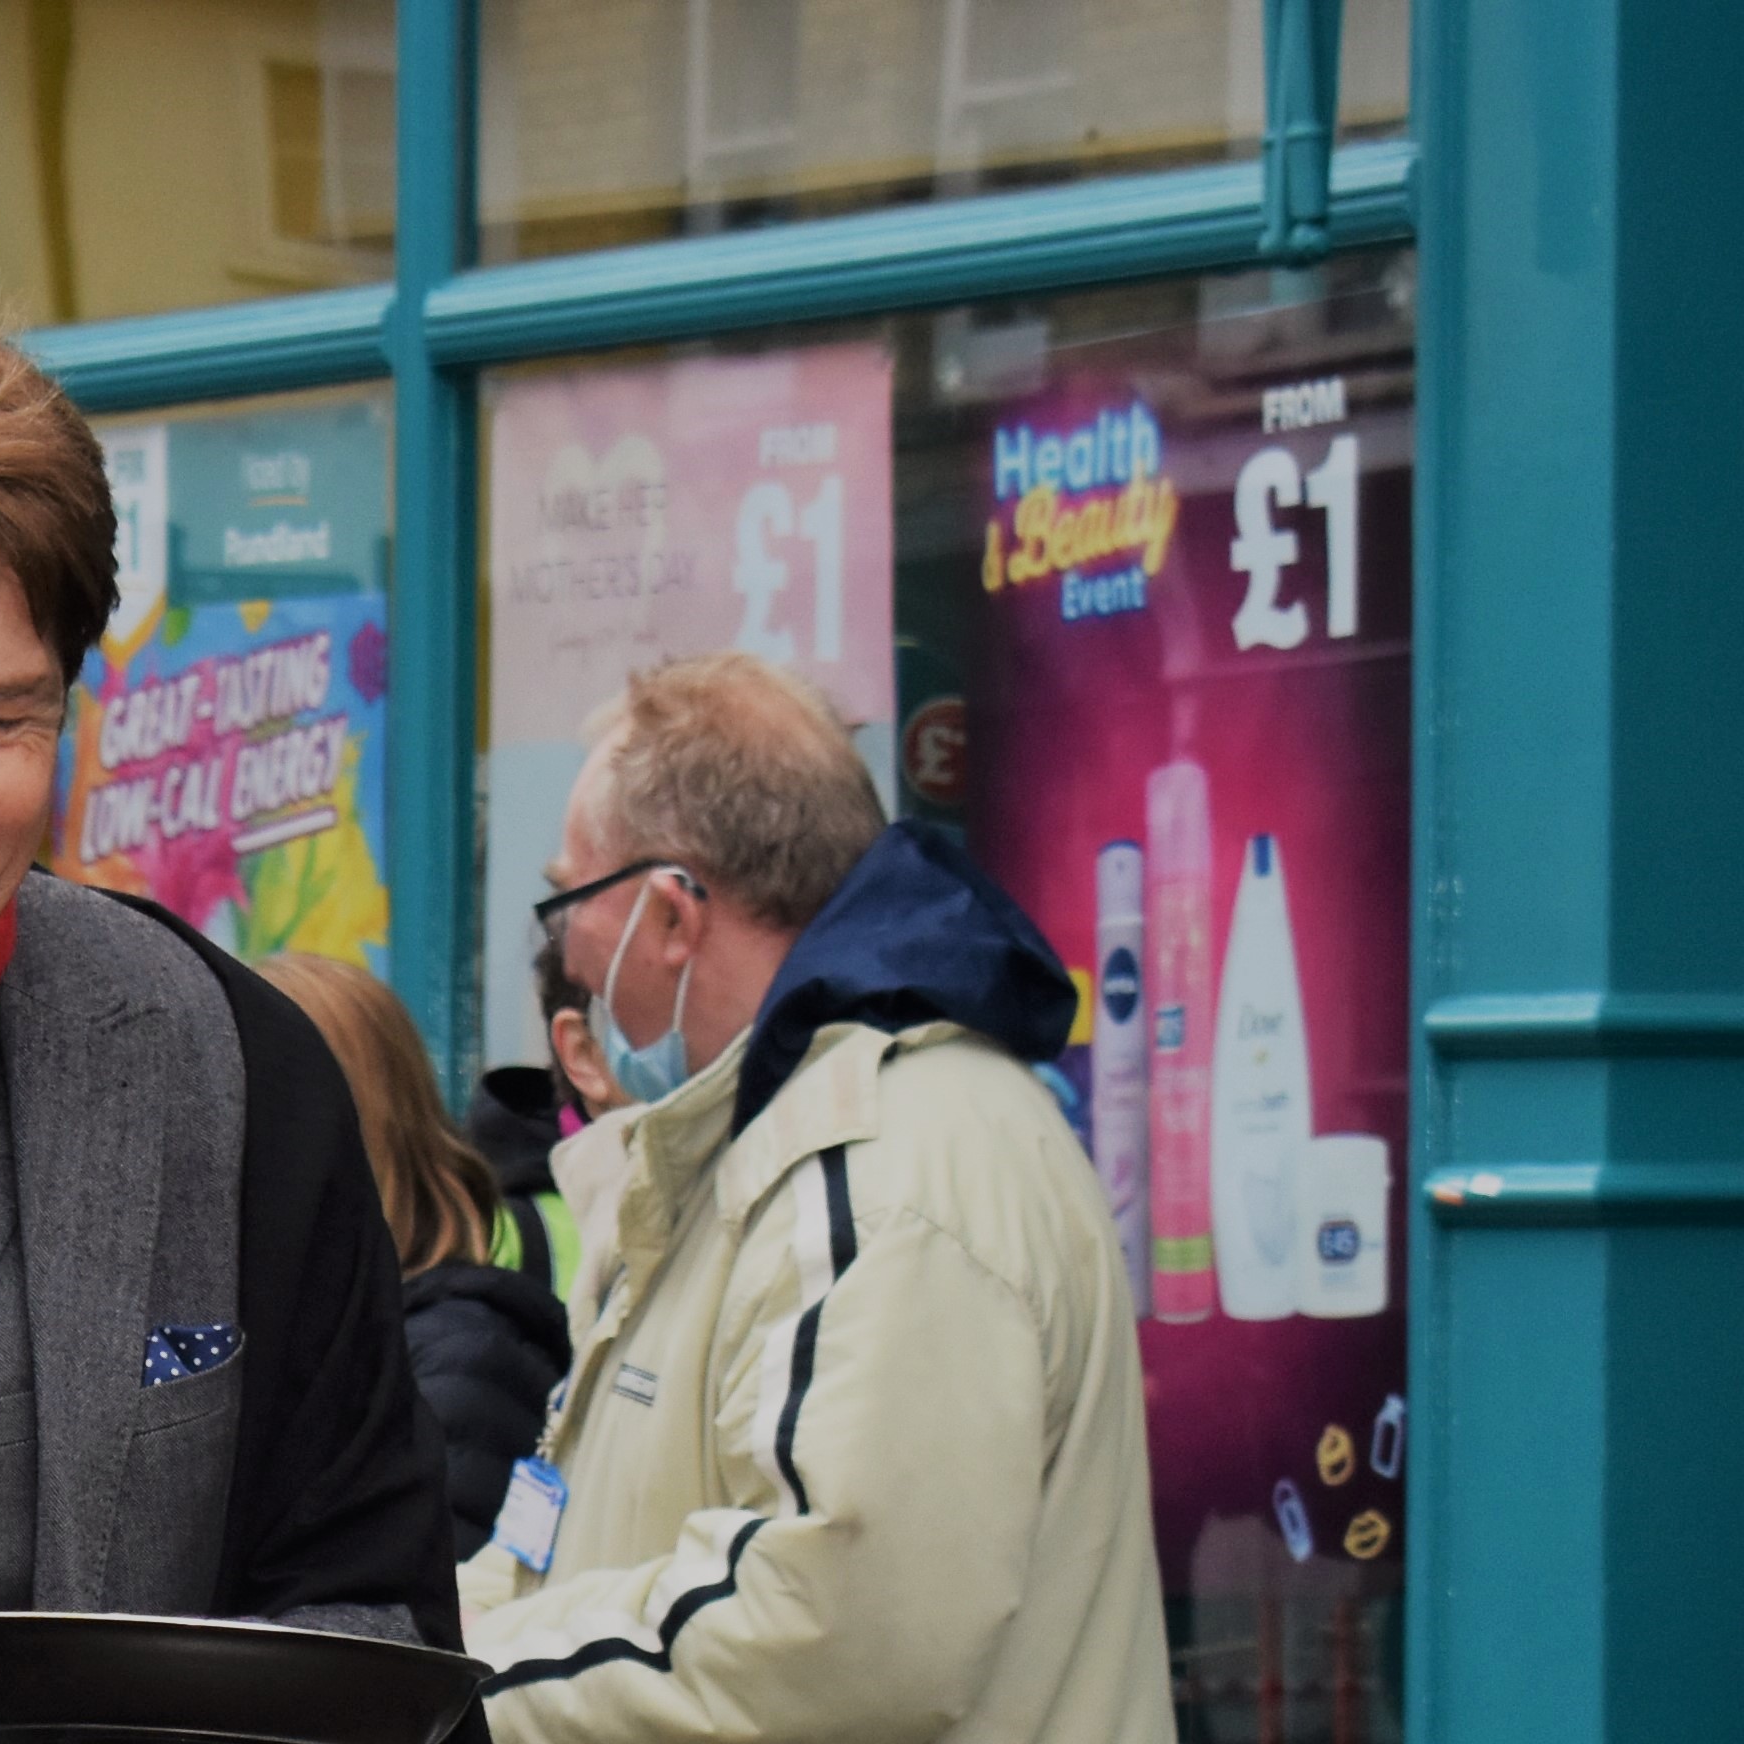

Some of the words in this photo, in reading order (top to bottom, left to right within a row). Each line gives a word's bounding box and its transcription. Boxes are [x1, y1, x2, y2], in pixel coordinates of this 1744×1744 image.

[993, 399, 1164, 502] Health
[1261, 374, 1346, 435] FROM
[732, 476, 843, 663] £1
[1007, 459, 1180, 585] Beauty
[1230, 432, 1360, 652] £1
[1060, 563, 1148, 622] Event
[99, 632, 331, 770] GREAT-TASTING
[79, 756, 223, 864] LOW-CAL
[230, 712, 349, 823] ENERGY
